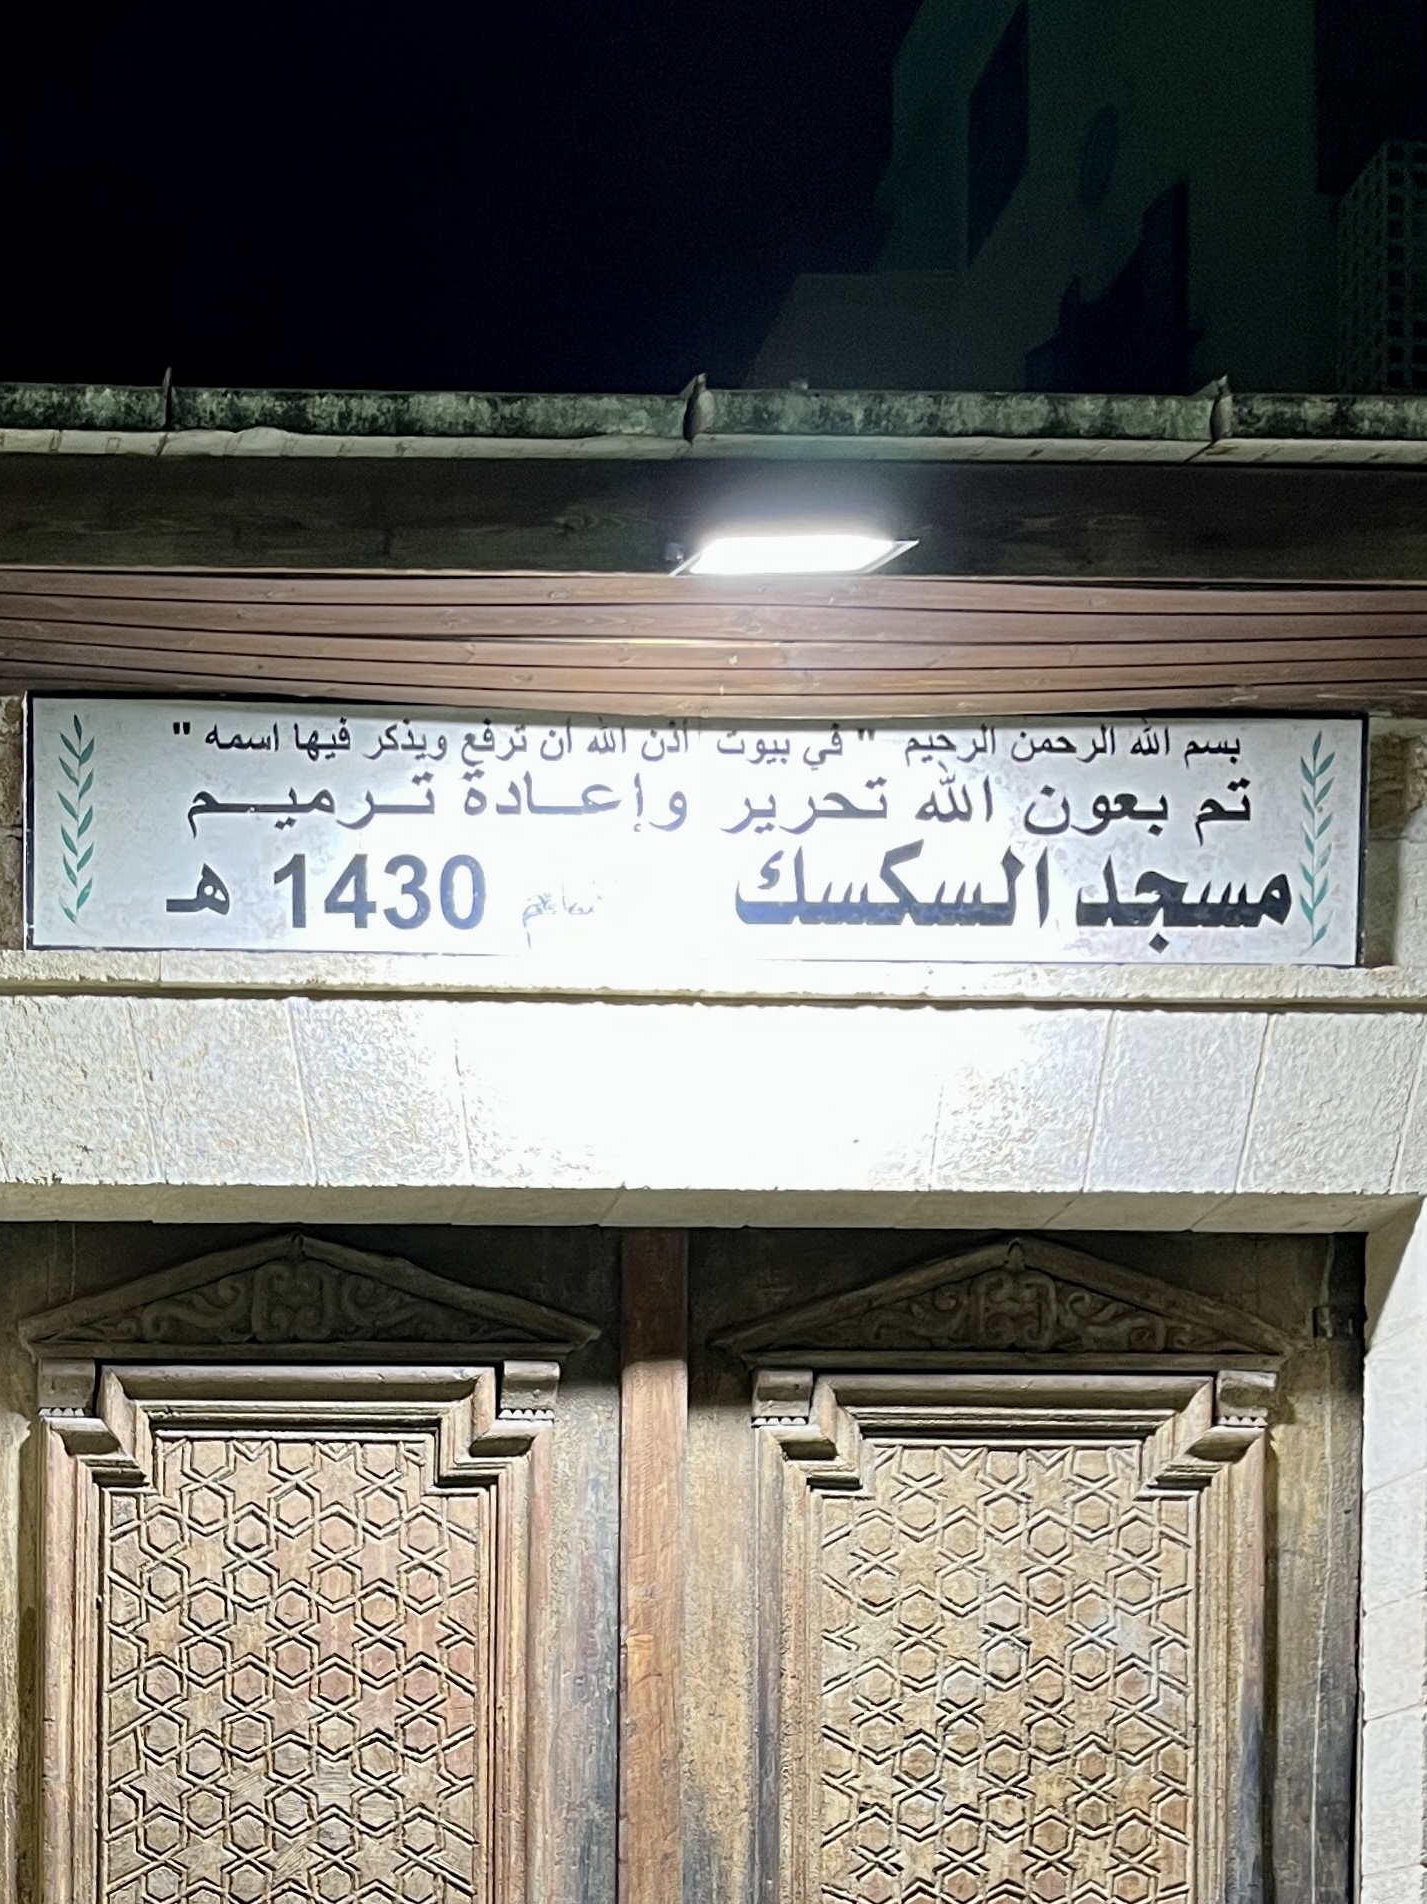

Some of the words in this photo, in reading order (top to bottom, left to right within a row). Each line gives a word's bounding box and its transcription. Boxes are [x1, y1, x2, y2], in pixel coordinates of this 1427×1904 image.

[293, 716, 352, 762] فيها
[362, 717, 449, 761] ويذكر
[460, 717, 528, 769] ترفع
[586, 715, 627, 755] الله
[716, 728, 791, 765] بيوت
[903, 722, 997, 767] الرحيم
[1010, 722, 1117, 764] الرحمن
[1129, 716, 1170, 757] الله
[1183, 735, 1241, 769] بسم
[719, 775, 888, 836] تحرير
[914, 760, 994, 824] الله
[1023, 784, 1169, 837] بعون
[1194, 777, 1251, 847] تم
[273, 852, 487, 930] 1430
[734, 838, 1050, 929] السكسك
[1075, 854, 1293, 955] مسجد
